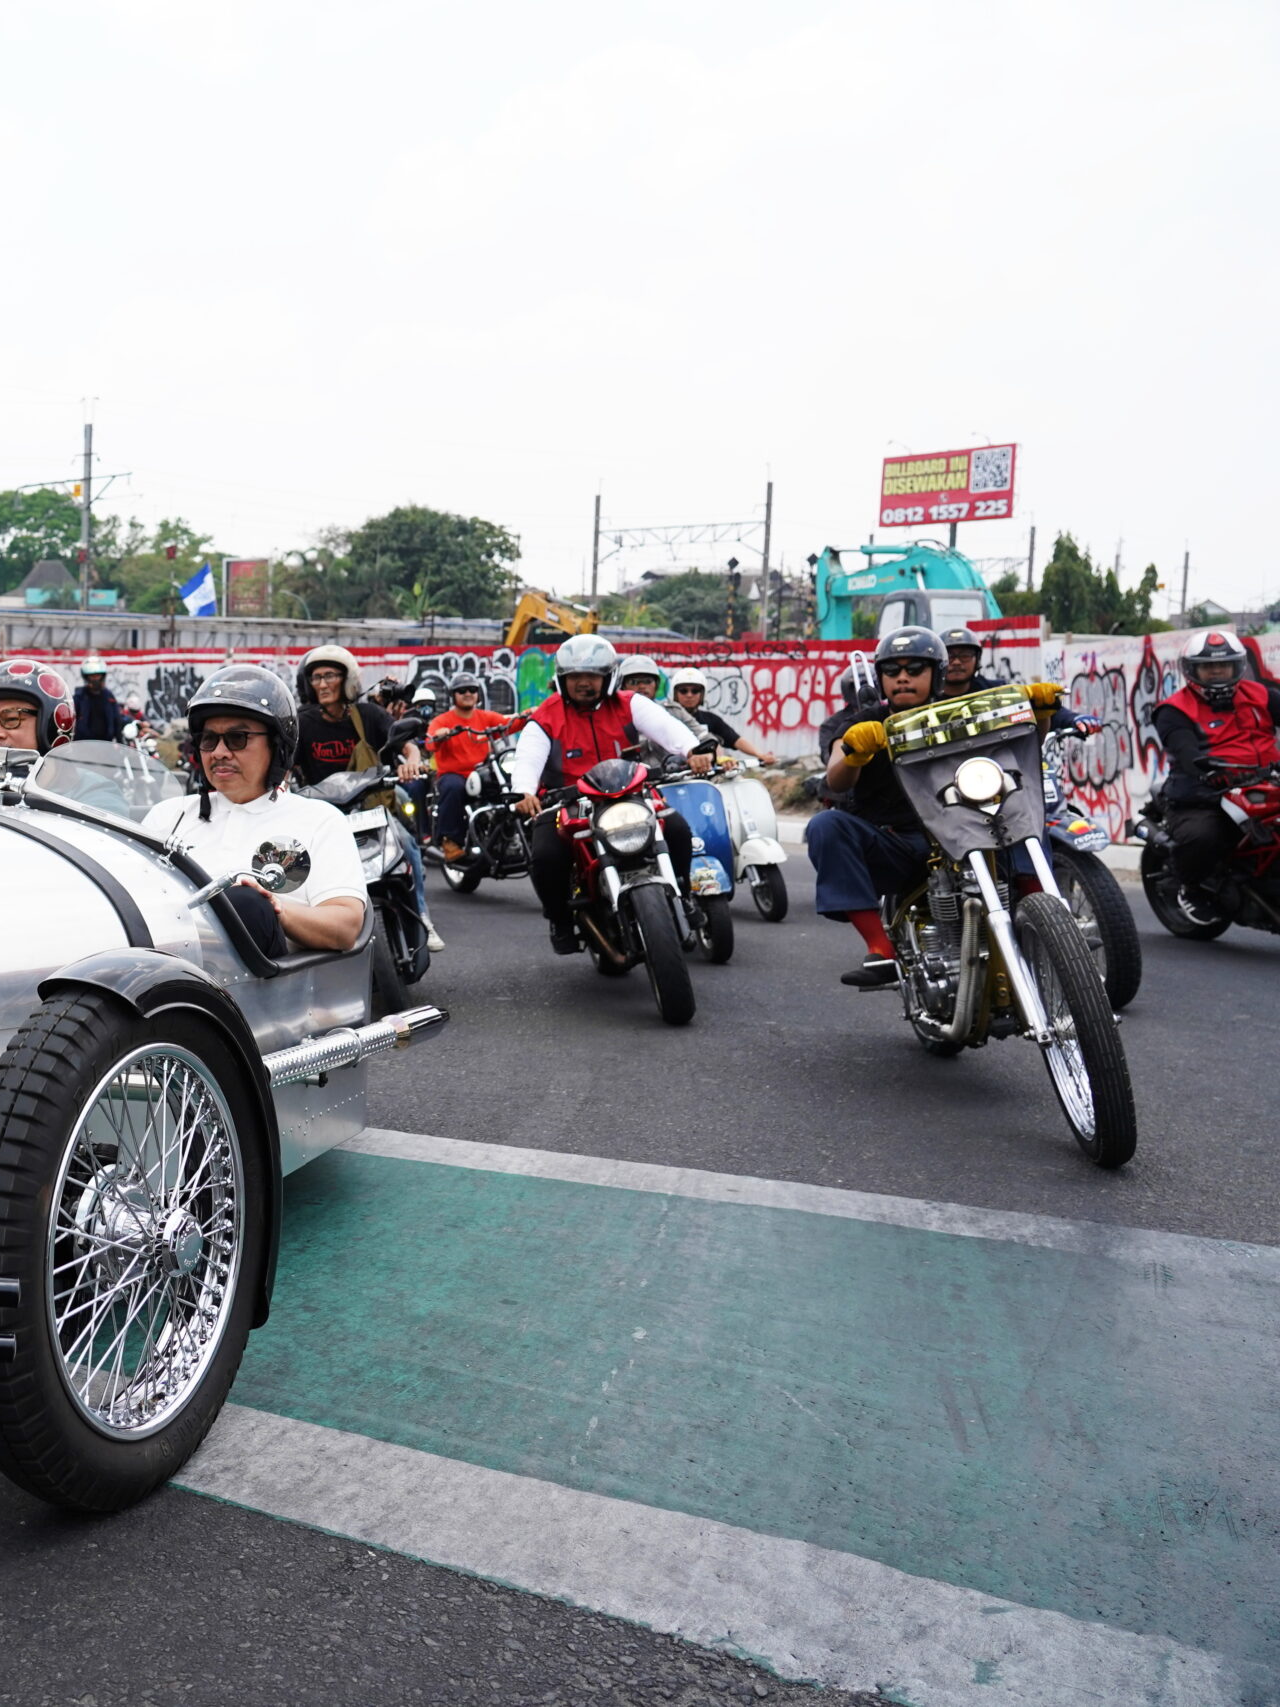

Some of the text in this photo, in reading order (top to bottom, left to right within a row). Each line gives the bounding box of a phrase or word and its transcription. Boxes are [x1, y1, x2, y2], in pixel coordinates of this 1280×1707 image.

[884, 455, 968, 478] BILLBOARD INI
[883, 470, 968, 496] DISEWAKAN
[881, 499, 1008, 524] 0812 1557 225
